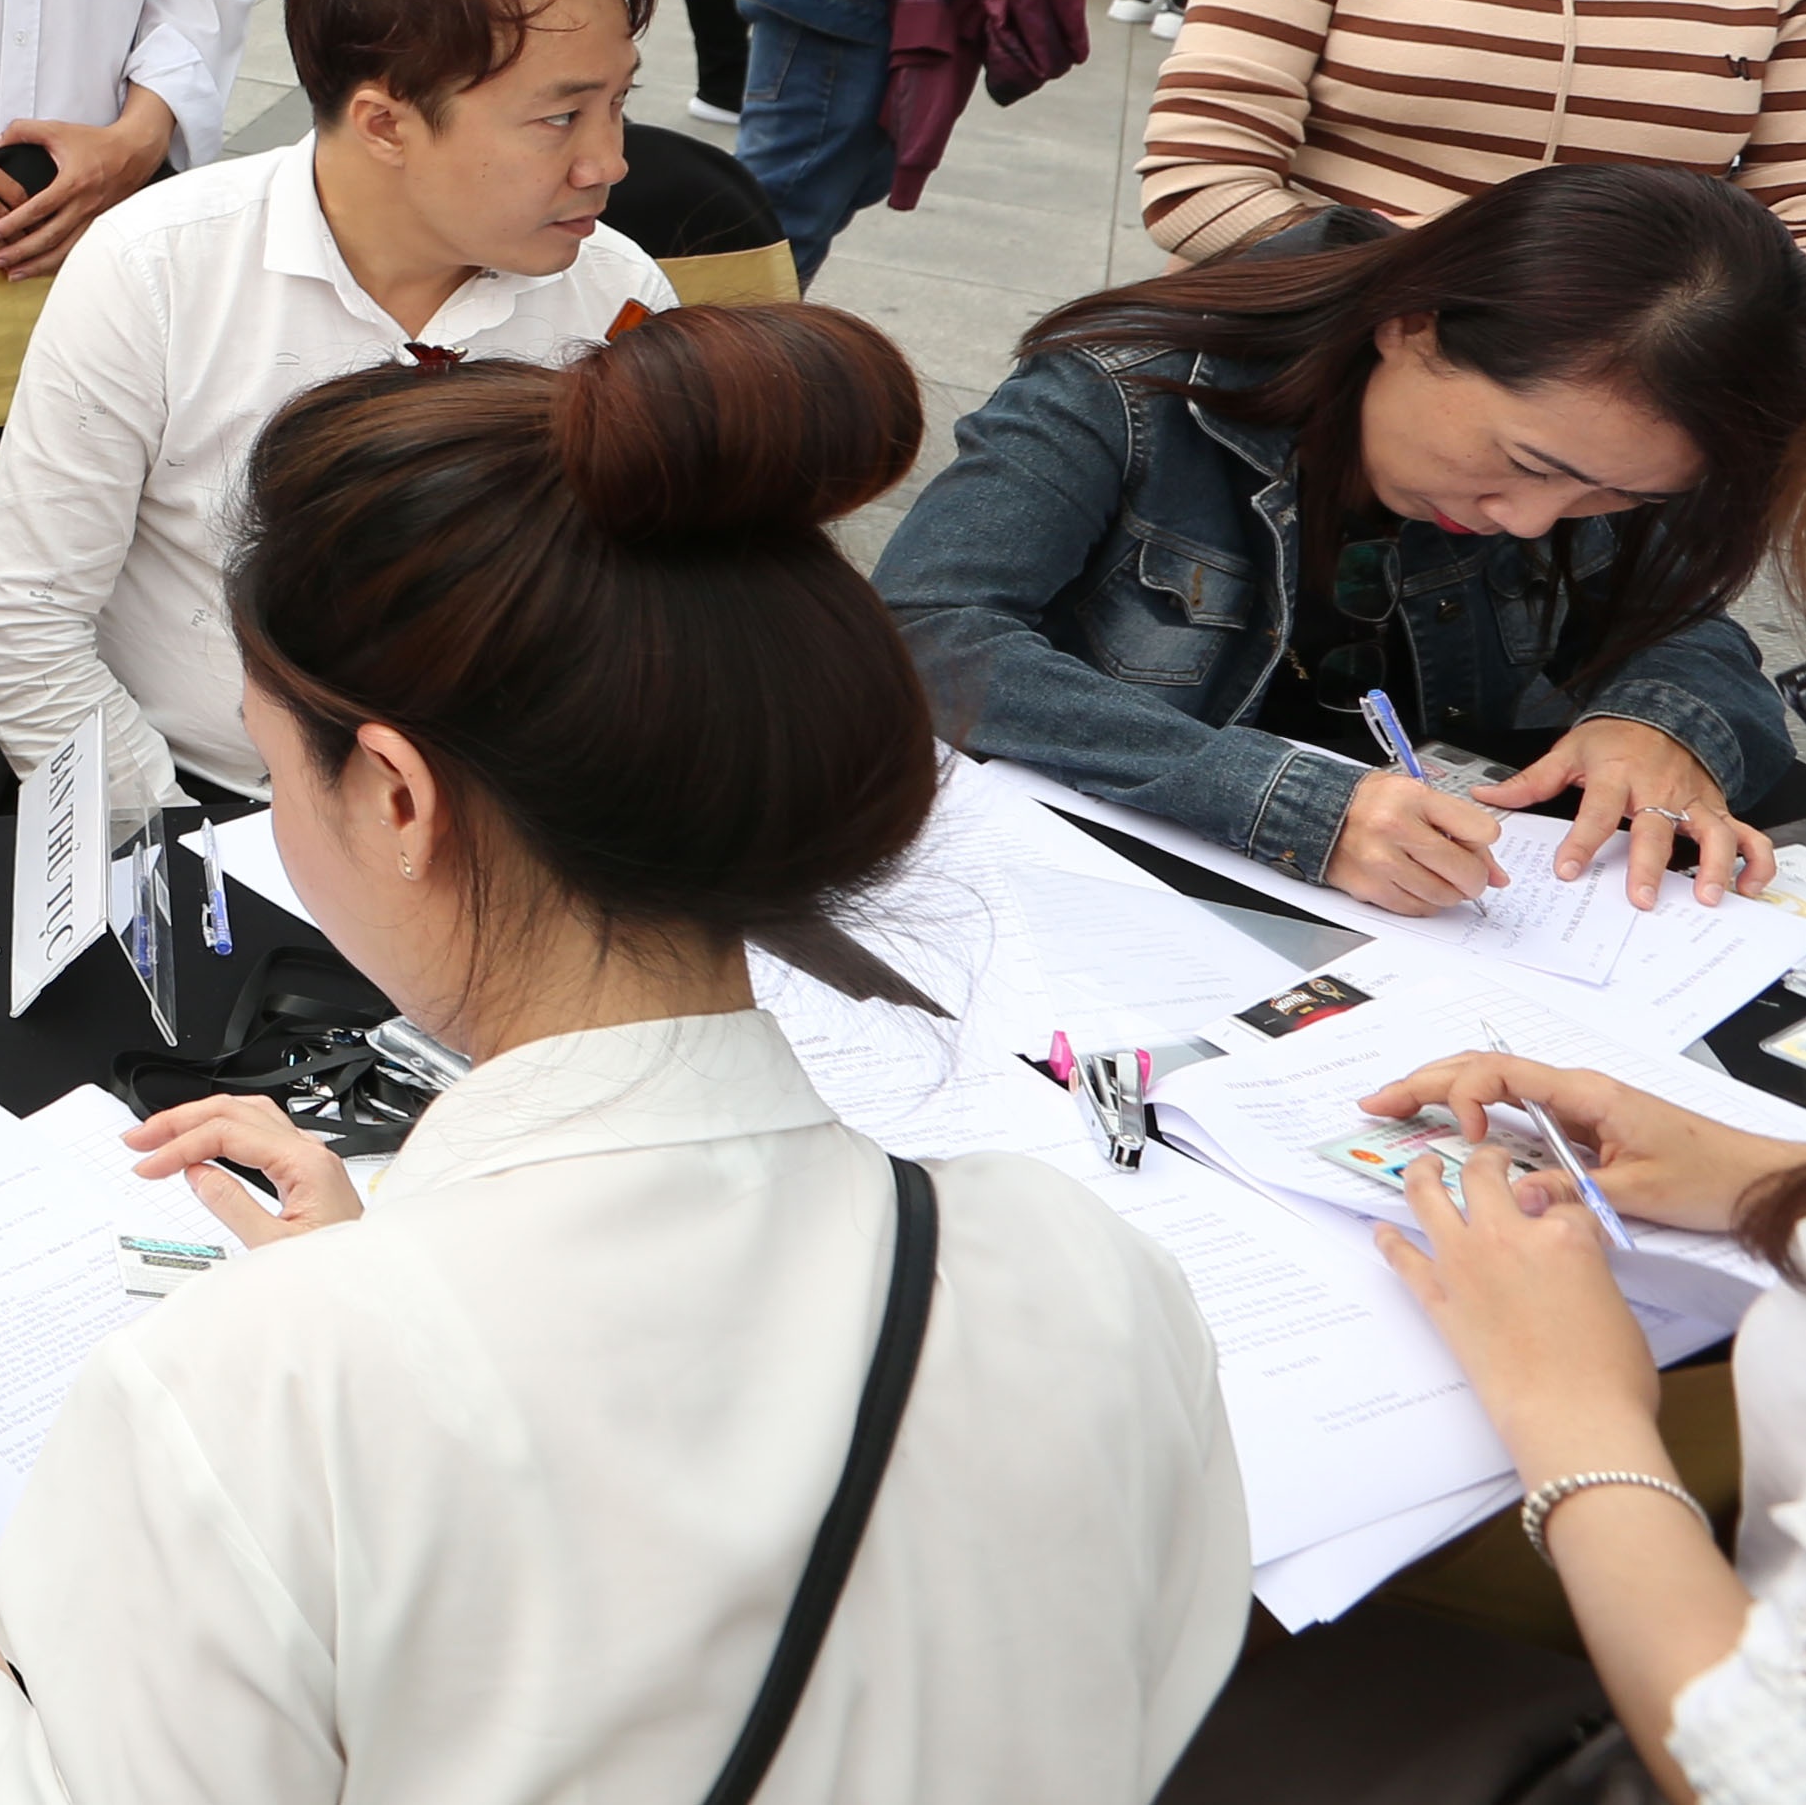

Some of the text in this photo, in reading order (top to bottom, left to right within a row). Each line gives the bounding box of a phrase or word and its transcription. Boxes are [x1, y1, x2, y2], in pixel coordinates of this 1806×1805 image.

[37, 740, 84, 962] BÀN THỦ TỤC
